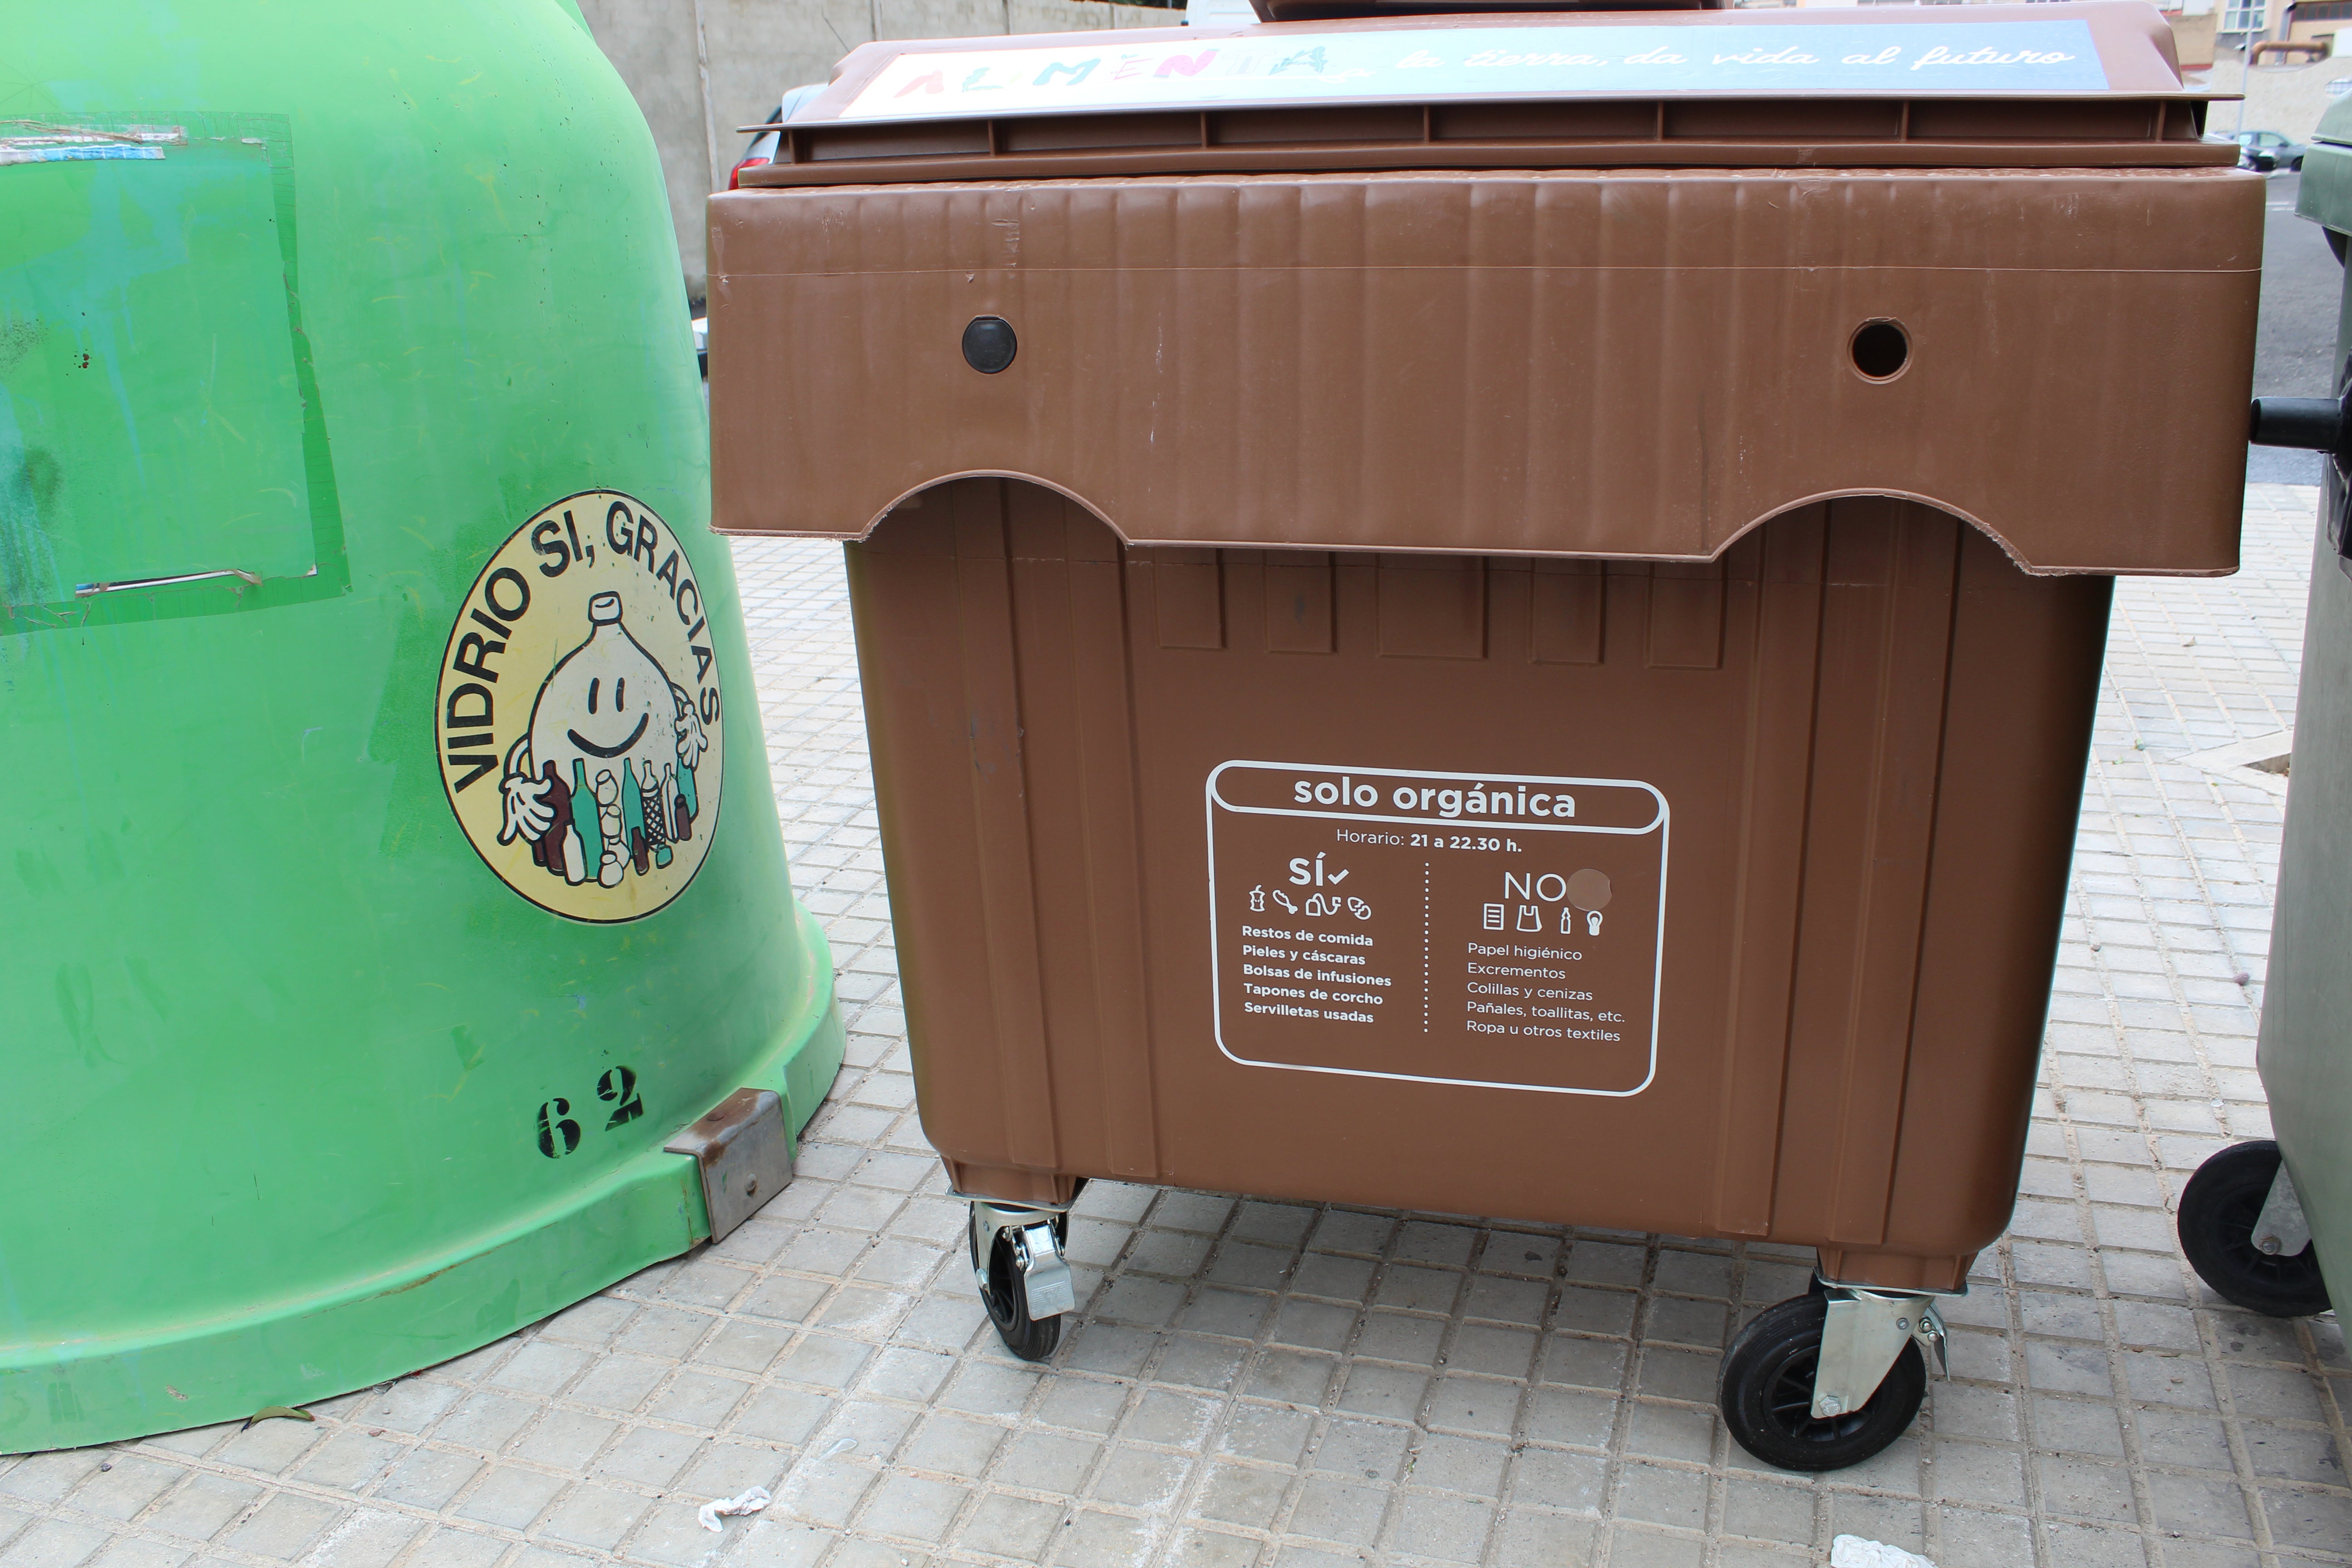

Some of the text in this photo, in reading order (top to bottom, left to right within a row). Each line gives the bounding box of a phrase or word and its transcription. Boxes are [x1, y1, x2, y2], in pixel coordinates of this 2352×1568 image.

[1396, 49, 1445, 68] la
[1464, 49, 1608, 68] tierra,
[1622, 46, 1688, 65] da
[1711, 47, 1819, 65] vida
[1841, 46, 1901, 65] al
[1910, 46, 2075, 70] futuro
[447, 501, 720, 794] VIDRIO SI, GRACIAS
[1294, 776, 1575, 818] solo orgánica
[1337, 828, 1522, 852] Horario: 21 a 22.30 h.
[1289, 851, 1326, 887] SÍ
[1504, 872, 1567, 902] NO
[1242, 925, 1373, 946] Restos de comida
[1243, 945, 1366, 965] Pieles y cáscaras
[1468, 942, 1582, 960] Papel higiénico
[1243, 964, 1392, 986] Bolsas de infusiones
[1468, 962, 1566, 979] Excrementos
[1243, 983, 1383, 1005] Tapones de corcho
[1467, 982, 1593, 1001] Colillas y cenizas
[1245, 1002, 1374, 1023] Servilletas usadas
[1467, 1001, 1625, 1022] Pañales, toallitas, etc.
[1467, 1020, 1620, 1042] Ropa u otros textiles
[537, 1065, 643, 1159] 62
